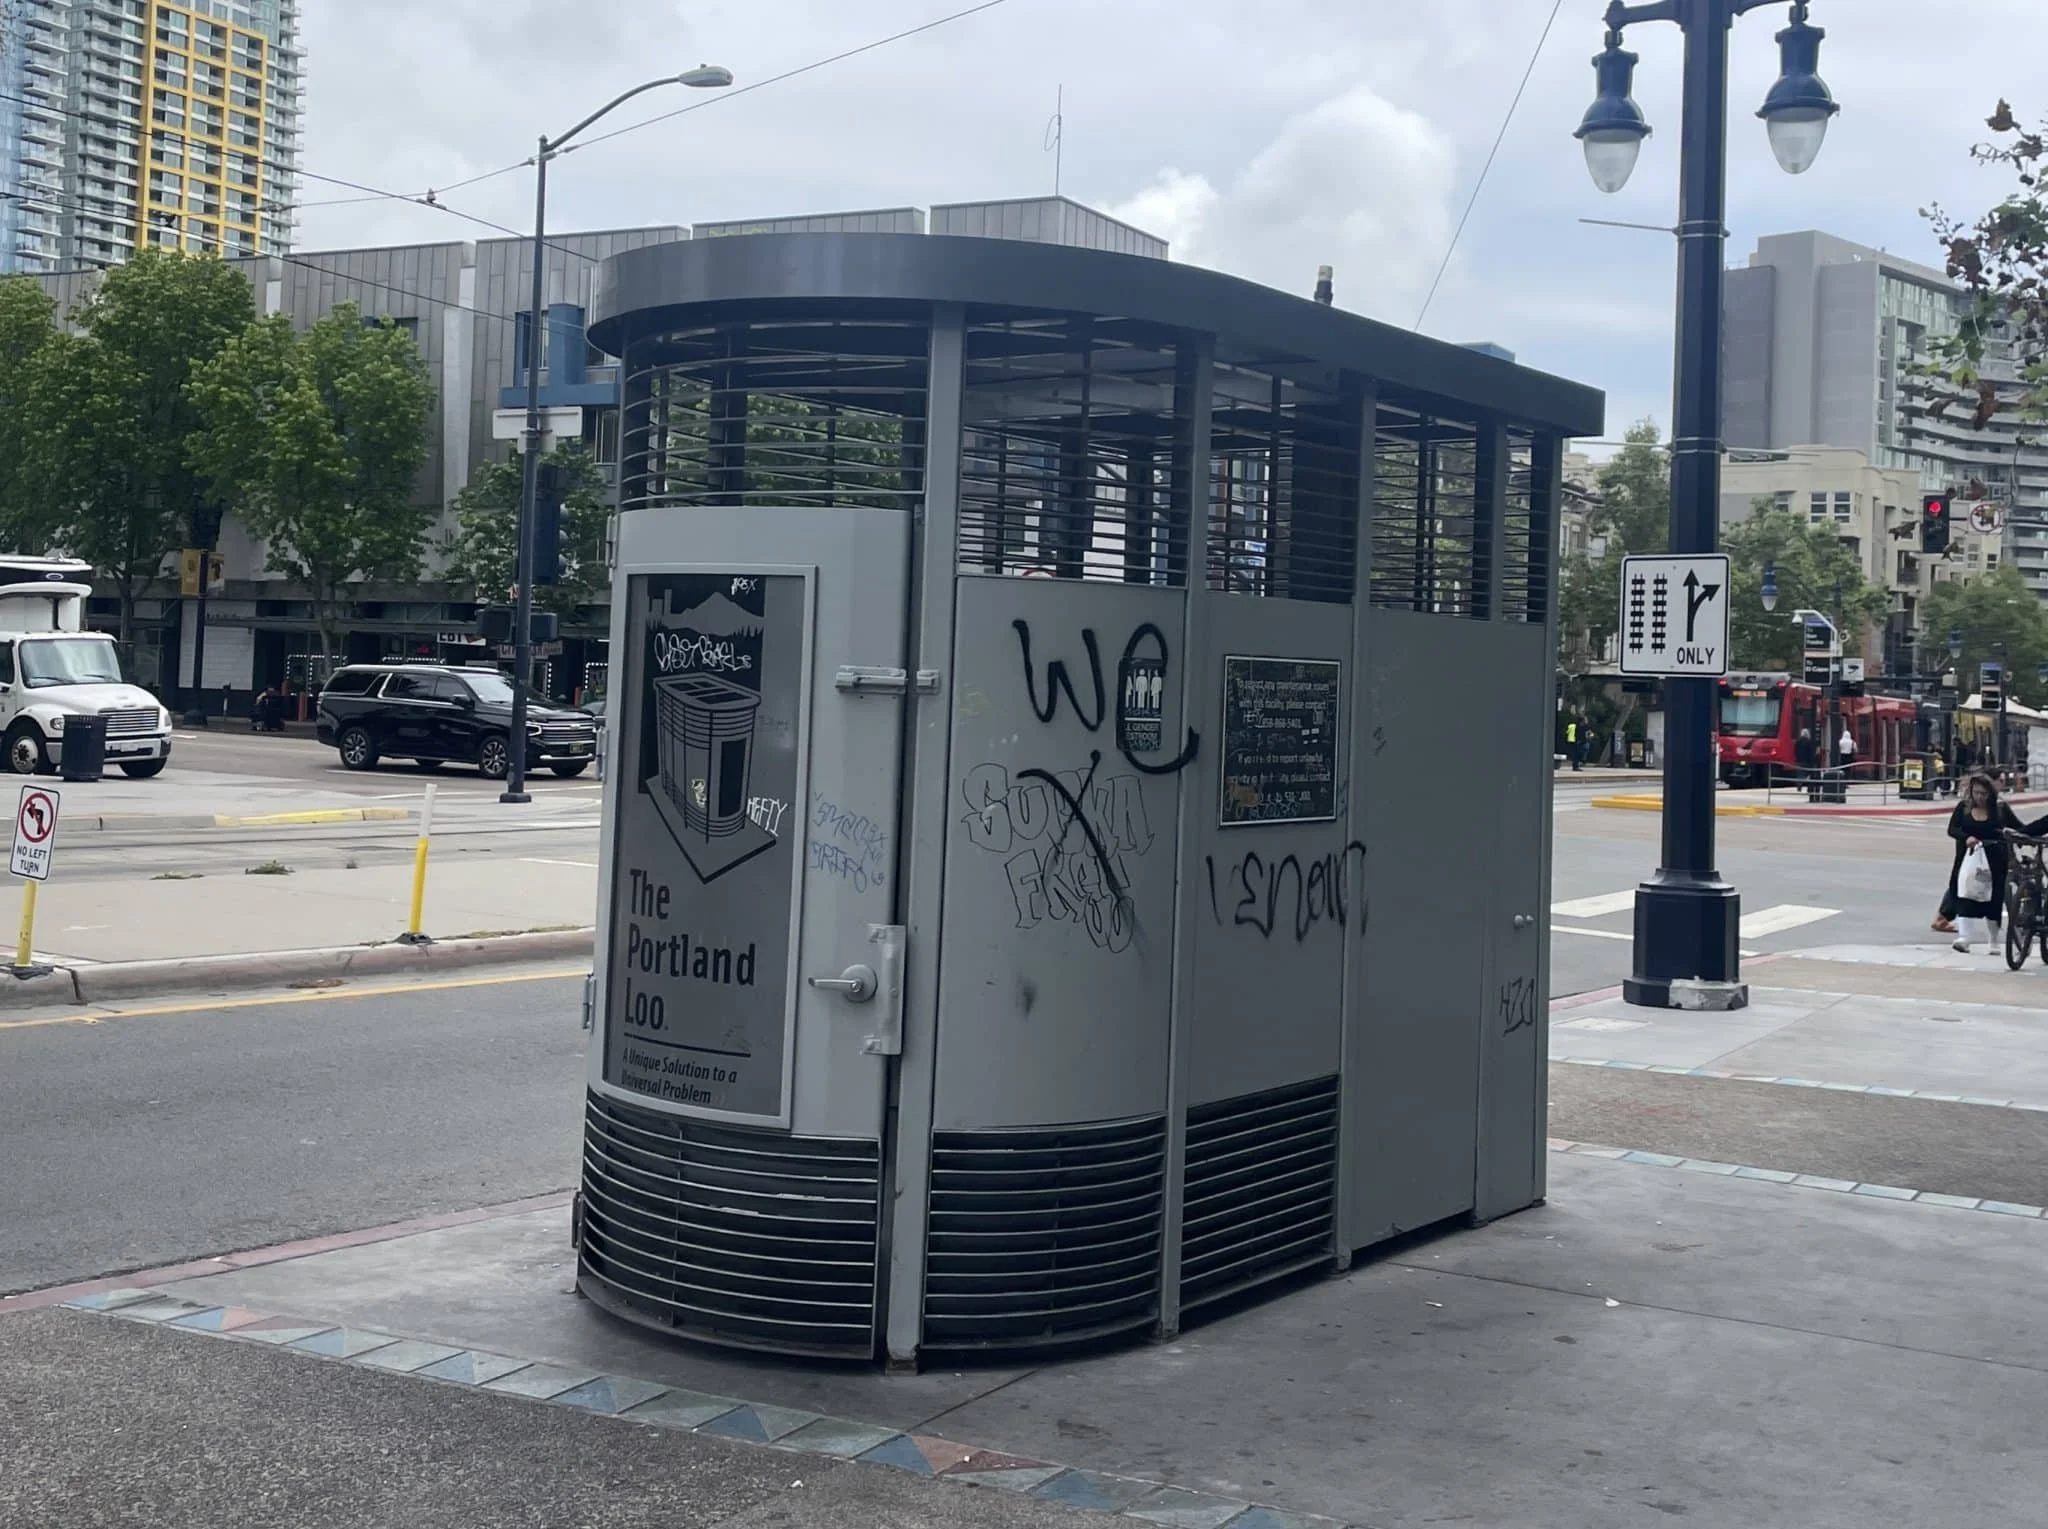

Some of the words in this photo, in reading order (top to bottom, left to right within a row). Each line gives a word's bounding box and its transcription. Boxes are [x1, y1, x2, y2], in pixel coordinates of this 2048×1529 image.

[1676, 647, 1715, 665] ONLY
[16, 845, 27, 856] NO
[29, 849, 47, 861] LEFT
[19, 860, 39, 874] TURN
[629, 868, 671, 920] The
[627, 923, 756, 986] Portland
[625, 977, 669, 1031] Loo.
[622, 1047, 628, 1062] A
[628, 1049, 660, 1073] Unique
[662, 1056, 710, 1080] Solution
[713, 1066, 726, 1082] to
[728, 1070, 738, 1084] a
[621, 1069, 662, 1095] Universal
[662, 1081, 712, 1105] Problem
